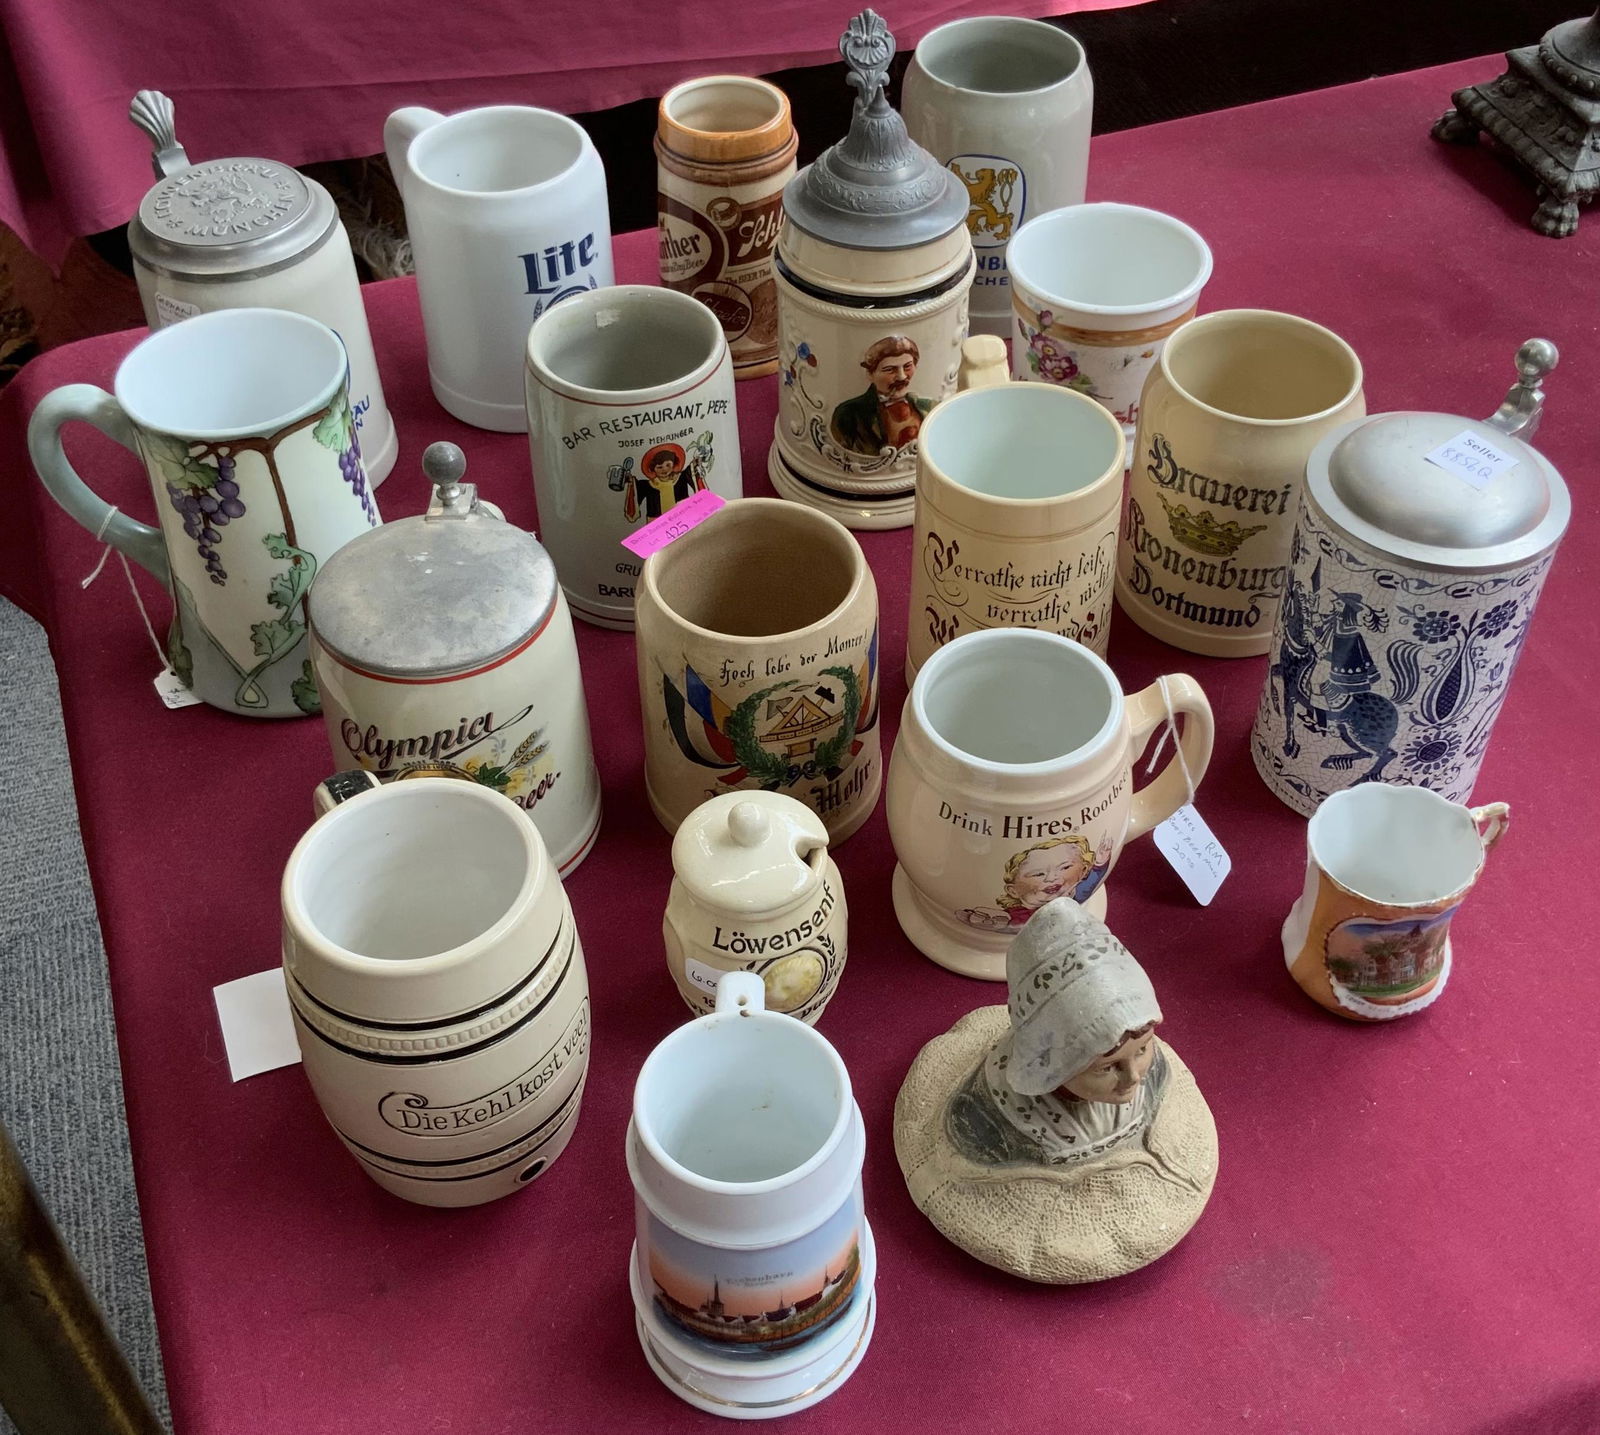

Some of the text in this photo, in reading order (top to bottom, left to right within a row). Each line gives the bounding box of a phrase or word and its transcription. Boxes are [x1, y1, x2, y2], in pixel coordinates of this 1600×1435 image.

[517, 231, 596, 295] Lite
[562, 427, 596, 450] BAR
[618, 426, 694, 448] JOSEF MEHRINGER
[1463, 438, 1503, 462] Seller
[1147, 433, 1292, 516] Brauerei
[665, 520, 690, 540] 425
[615, 563, 641, 577] GRU
[1129, 555, 1261, 628] Dortmund
[341, 704, 533, 769] Olympia
[938, 800, 993, 837] Drink
[1002, 815, 1073, 839] Hires
[1204, 841, 1223, 866] RM
[712, 879, 835, 954] Löwensenf
[396, 1108, 448, 1130] Die
